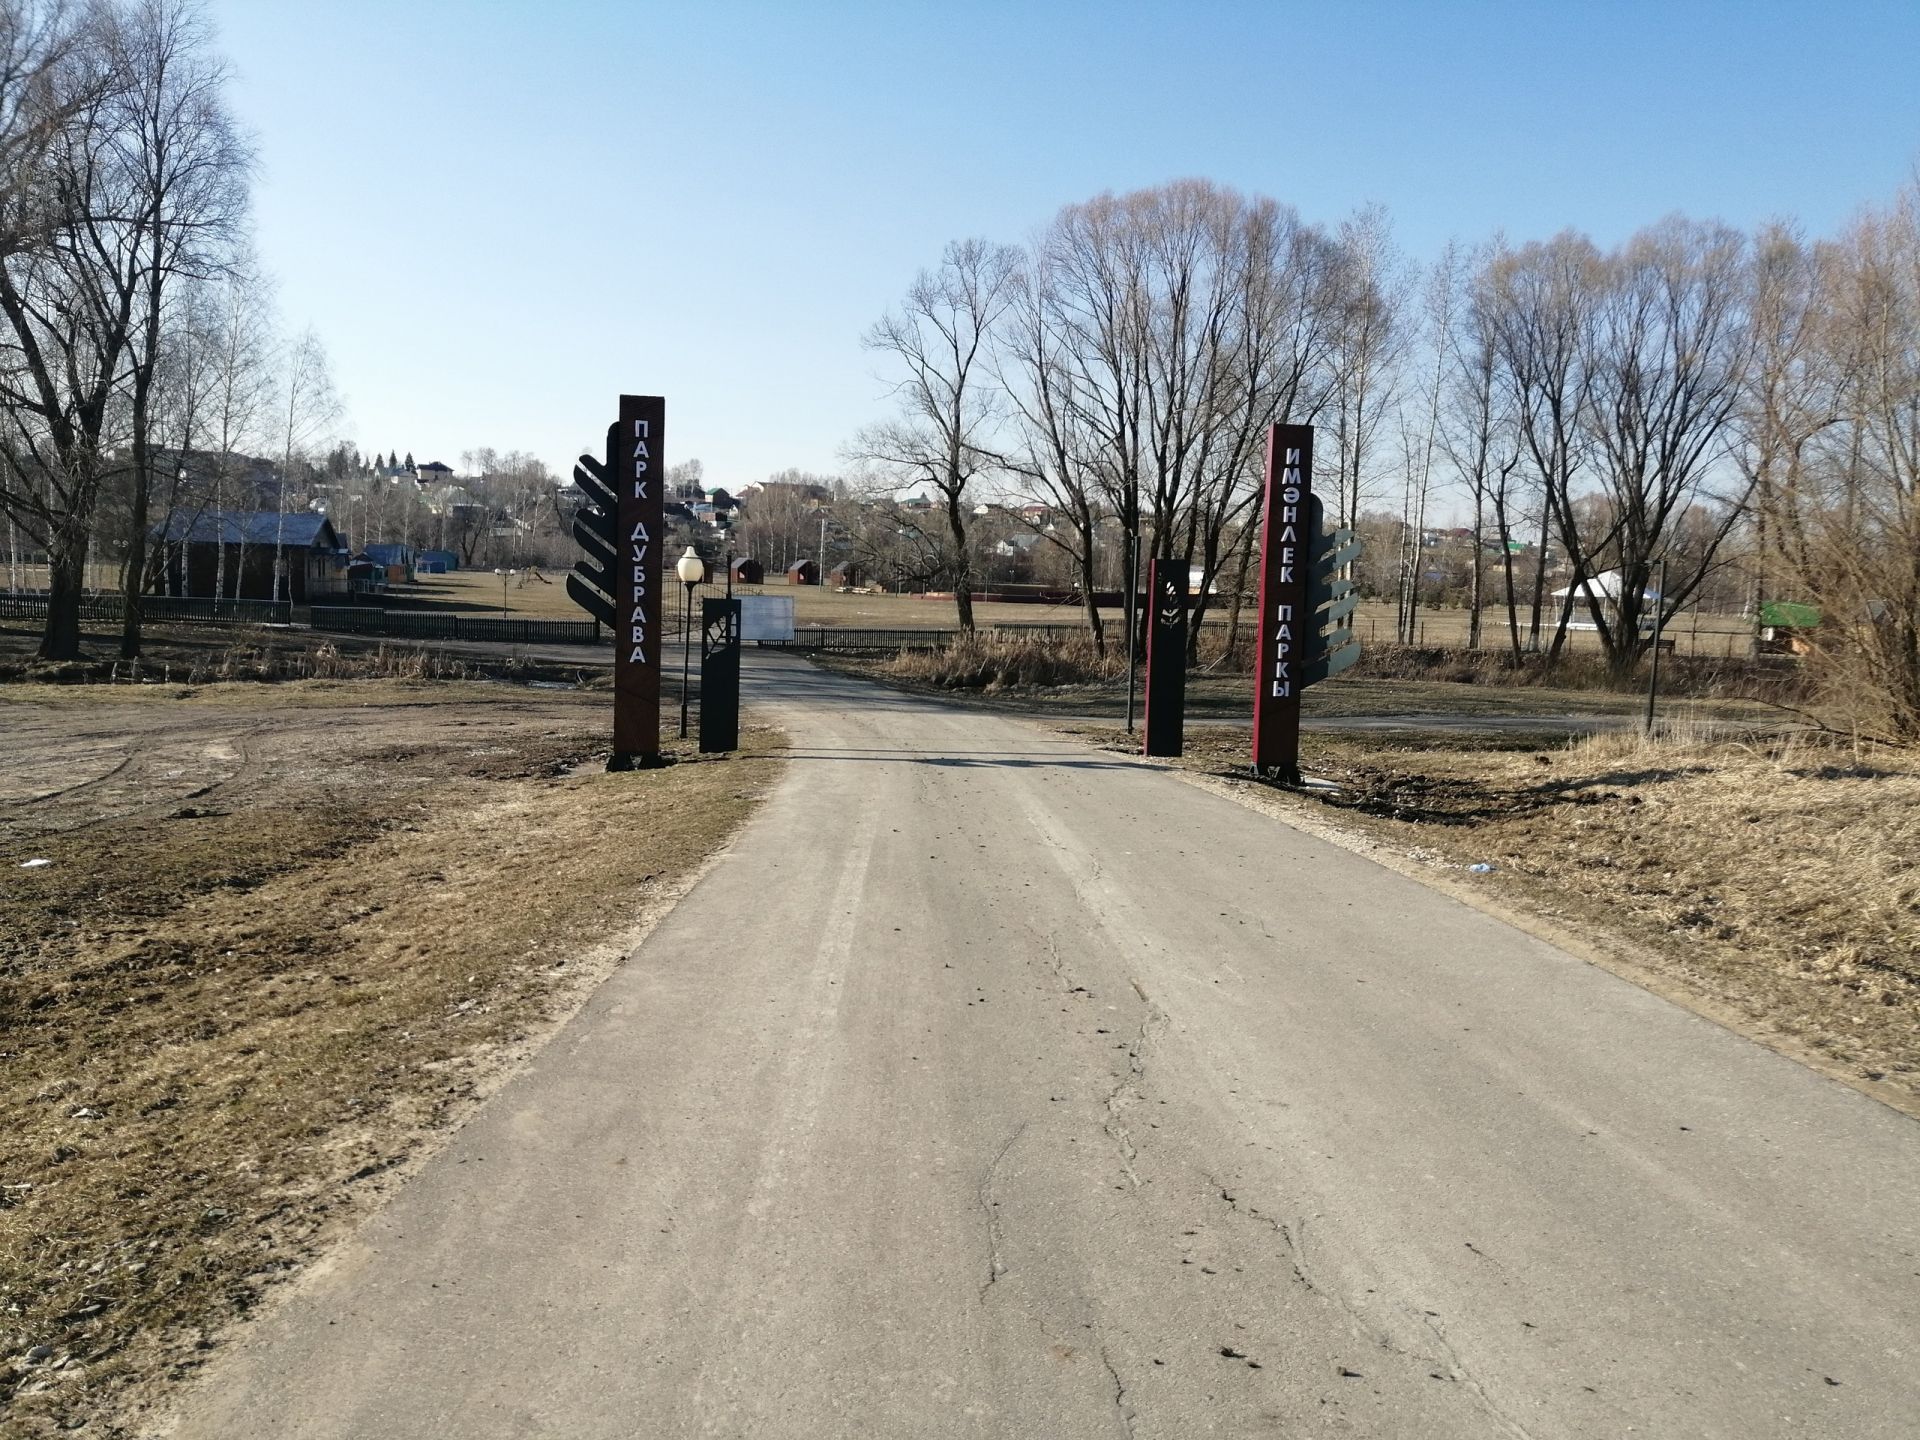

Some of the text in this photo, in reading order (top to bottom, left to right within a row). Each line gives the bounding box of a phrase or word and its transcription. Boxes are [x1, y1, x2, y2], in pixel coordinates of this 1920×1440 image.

[629, 419, 649, 664] ПАРК ДУБРАВА
[1272, 604, 1292, 697] ПАРКЫ
